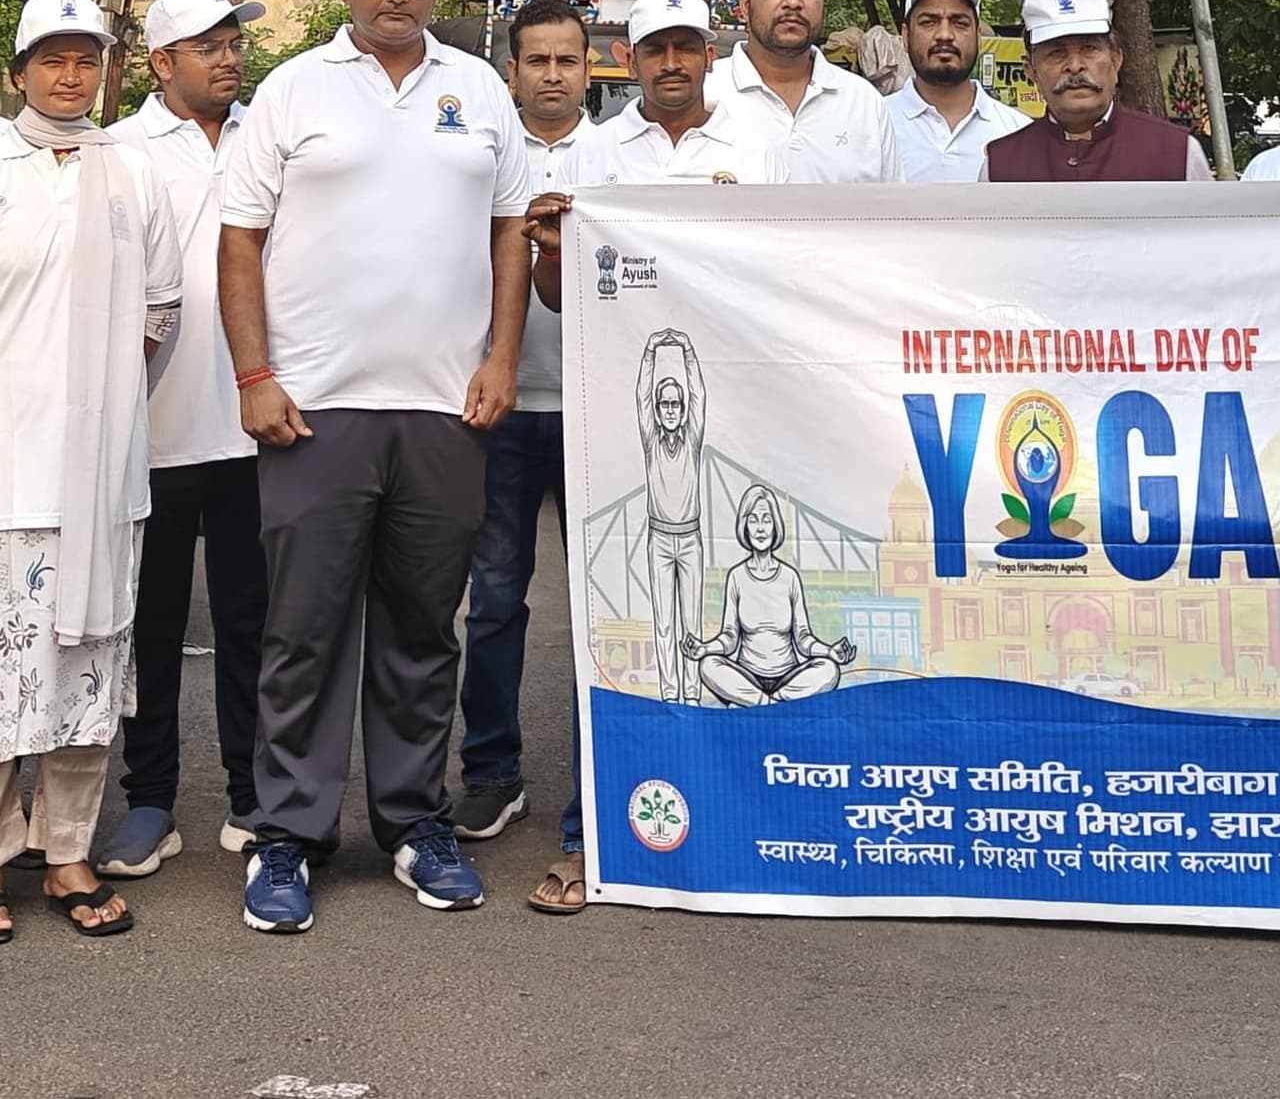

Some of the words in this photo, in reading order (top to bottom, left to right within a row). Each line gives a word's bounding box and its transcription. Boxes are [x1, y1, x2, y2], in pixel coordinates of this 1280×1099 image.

[622, 266, 658, 283] Ayush
[902, 329, 1147, 374] INTERNATIONAL
[1154, 328, 1211, 372] DAY
[1222, 327, 1260, 371] OF
[996, 562, 1017, 575] Yoga
[1017, 562, 1028, 572] for
[1029, 562, 1059, 575] Healthy
[1060, 563, 1088, 575] Ageing
[763, 754, 851, 789] जिला
[860, 764, 959, 797] आयुष
[967, 760, 1094, 798] समिति,
[1104, 763, 1279, 796] हजारीबाग
[844, 796, 955, 835] राष्ट्रीय
[965, 806, 1067, 843] आयुष
[1075, 802, 1198, 841] मिशन,
[972, 839, 1037, 872] शिक्षा
[1044, 843, 1085, 877] एवं
[1088, 844, 1170, 873] परिवार
[1177, 851, 1273, 874] कल्याण
